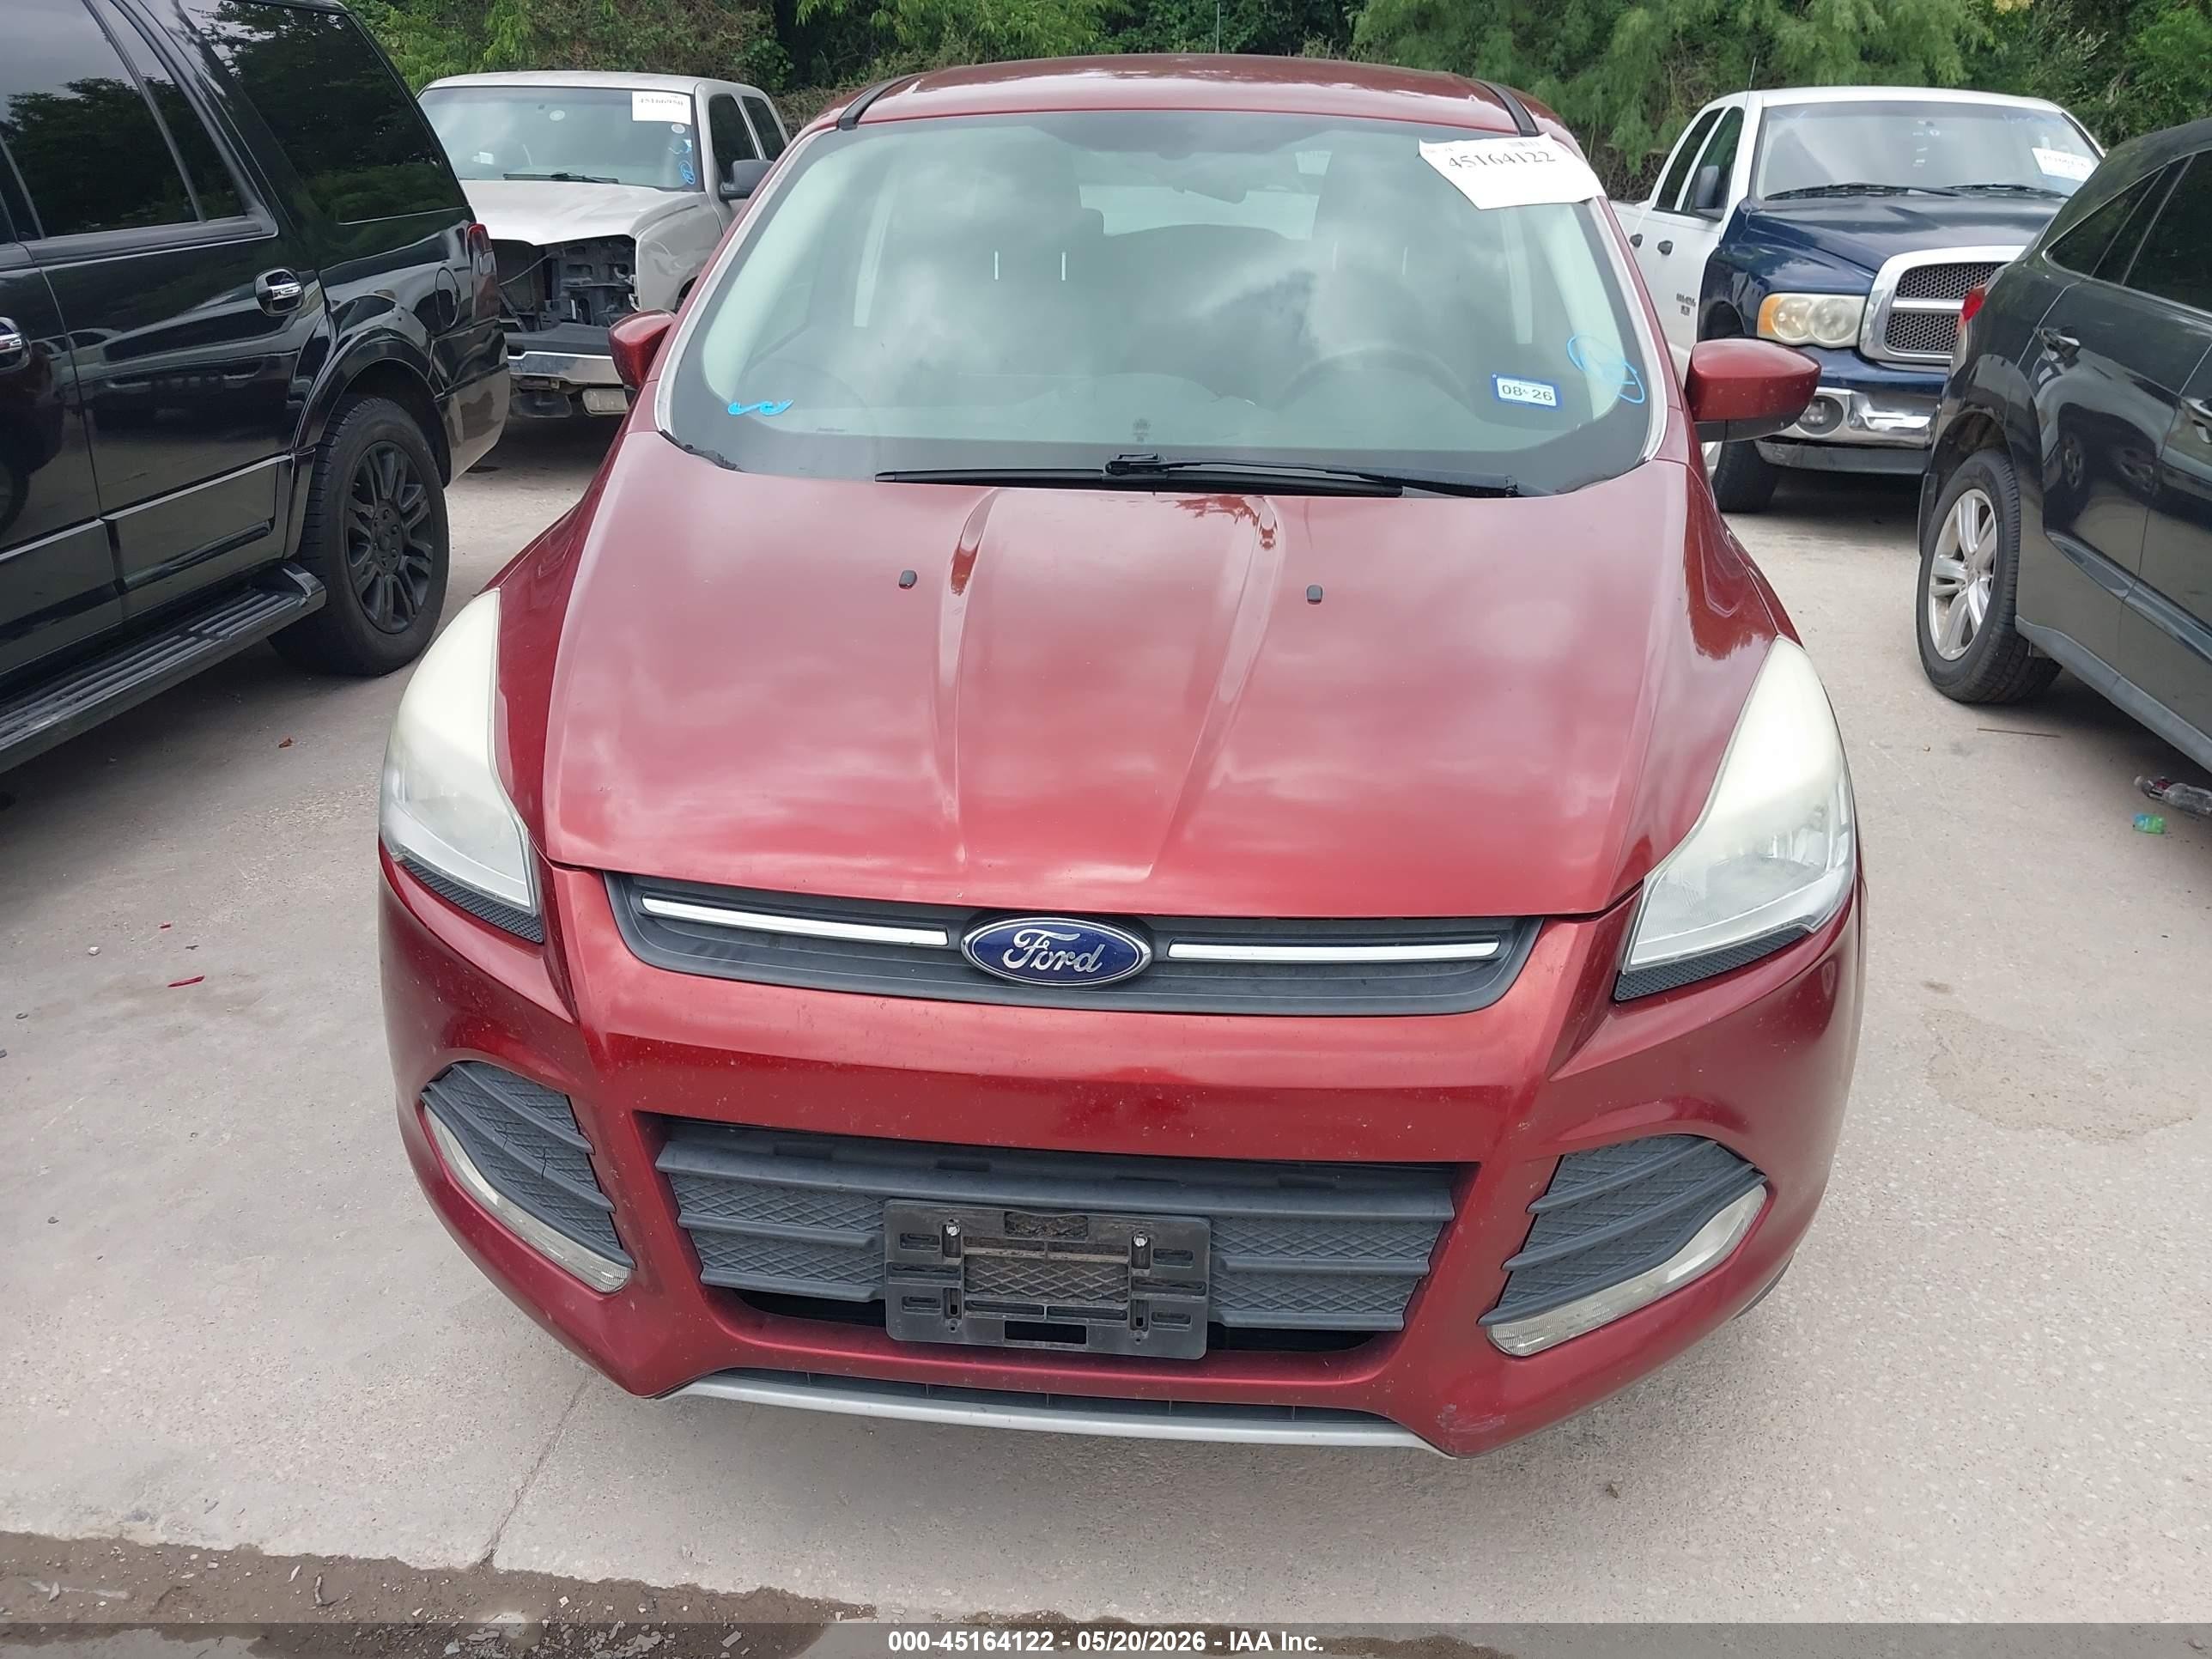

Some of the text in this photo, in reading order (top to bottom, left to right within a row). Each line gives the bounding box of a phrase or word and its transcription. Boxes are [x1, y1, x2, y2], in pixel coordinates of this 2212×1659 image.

[1449, 150, 1557, 168] 45164122
[1502, 384, 1553, 402] 08 26
[1002, 928, 1104, 973] Ford
